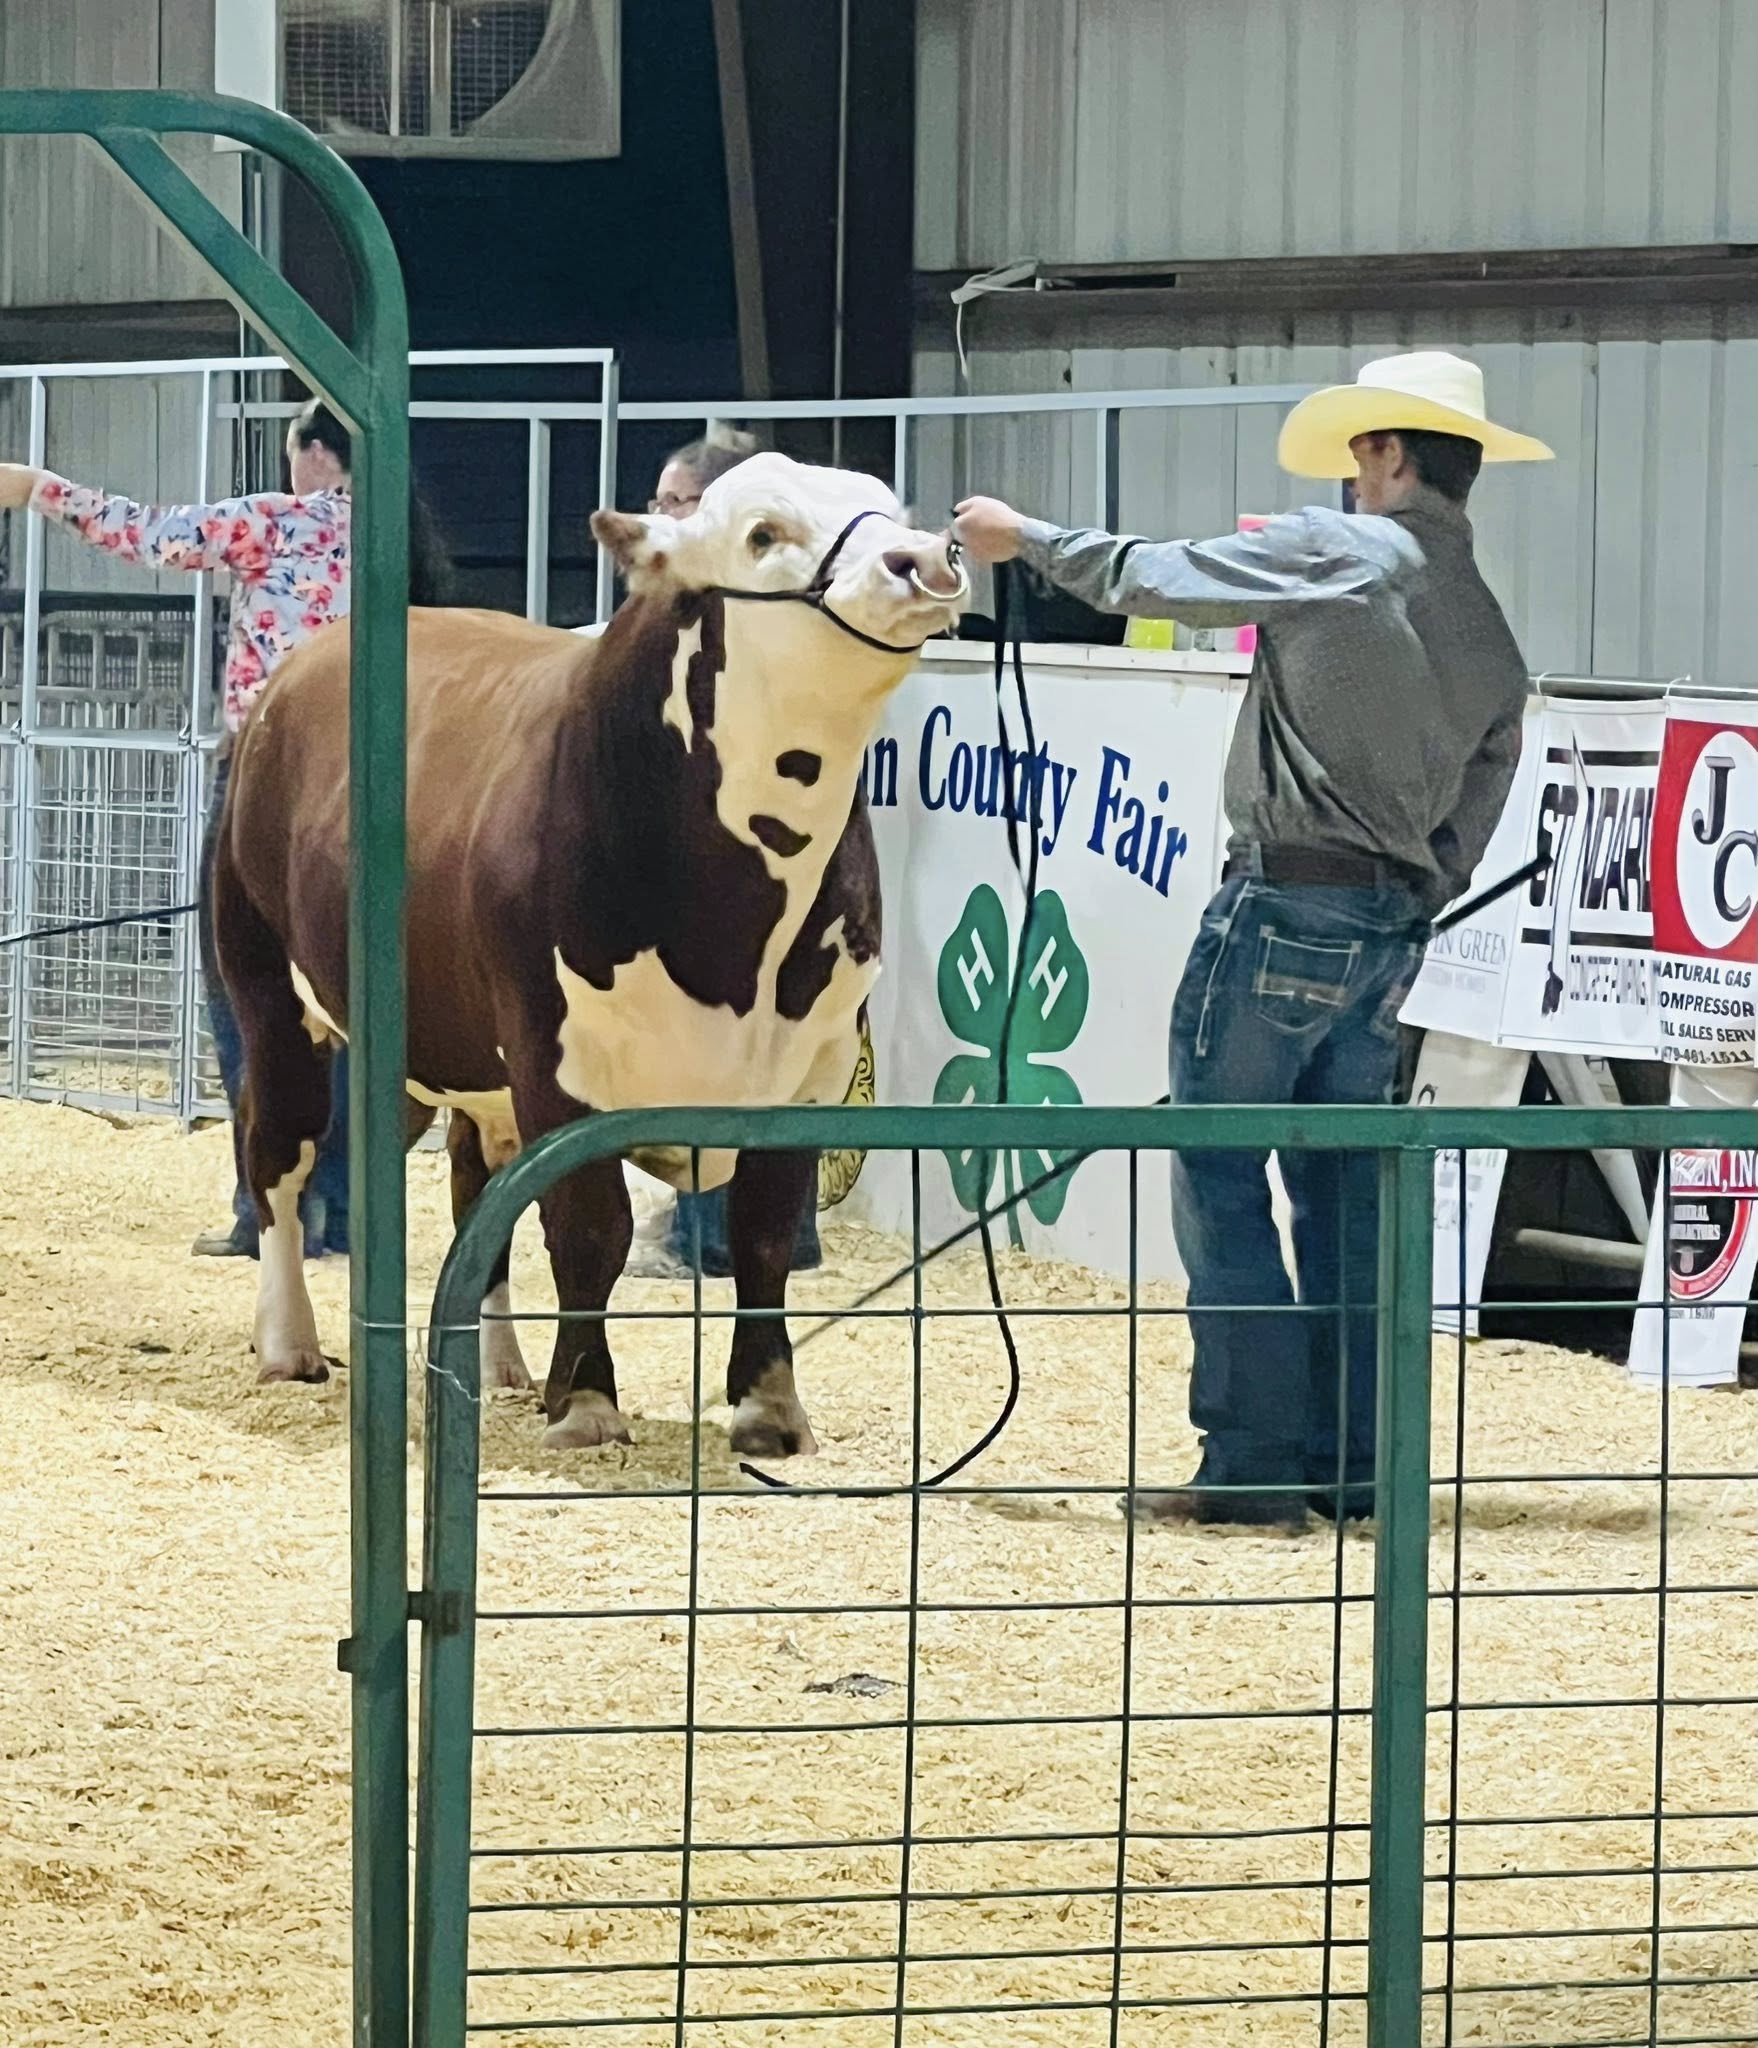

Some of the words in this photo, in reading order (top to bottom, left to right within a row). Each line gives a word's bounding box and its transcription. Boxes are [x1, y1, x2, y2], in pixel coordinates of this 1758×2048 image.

[919, 705, 1077, 857] County
[1087, 745, 1187, 898] Fair
[1725, 969, 1752, 988] GAS
[1658, 990, 1755, 1017] OMPRESSOR
[1678, 1023, 1714, 1041] SALES
